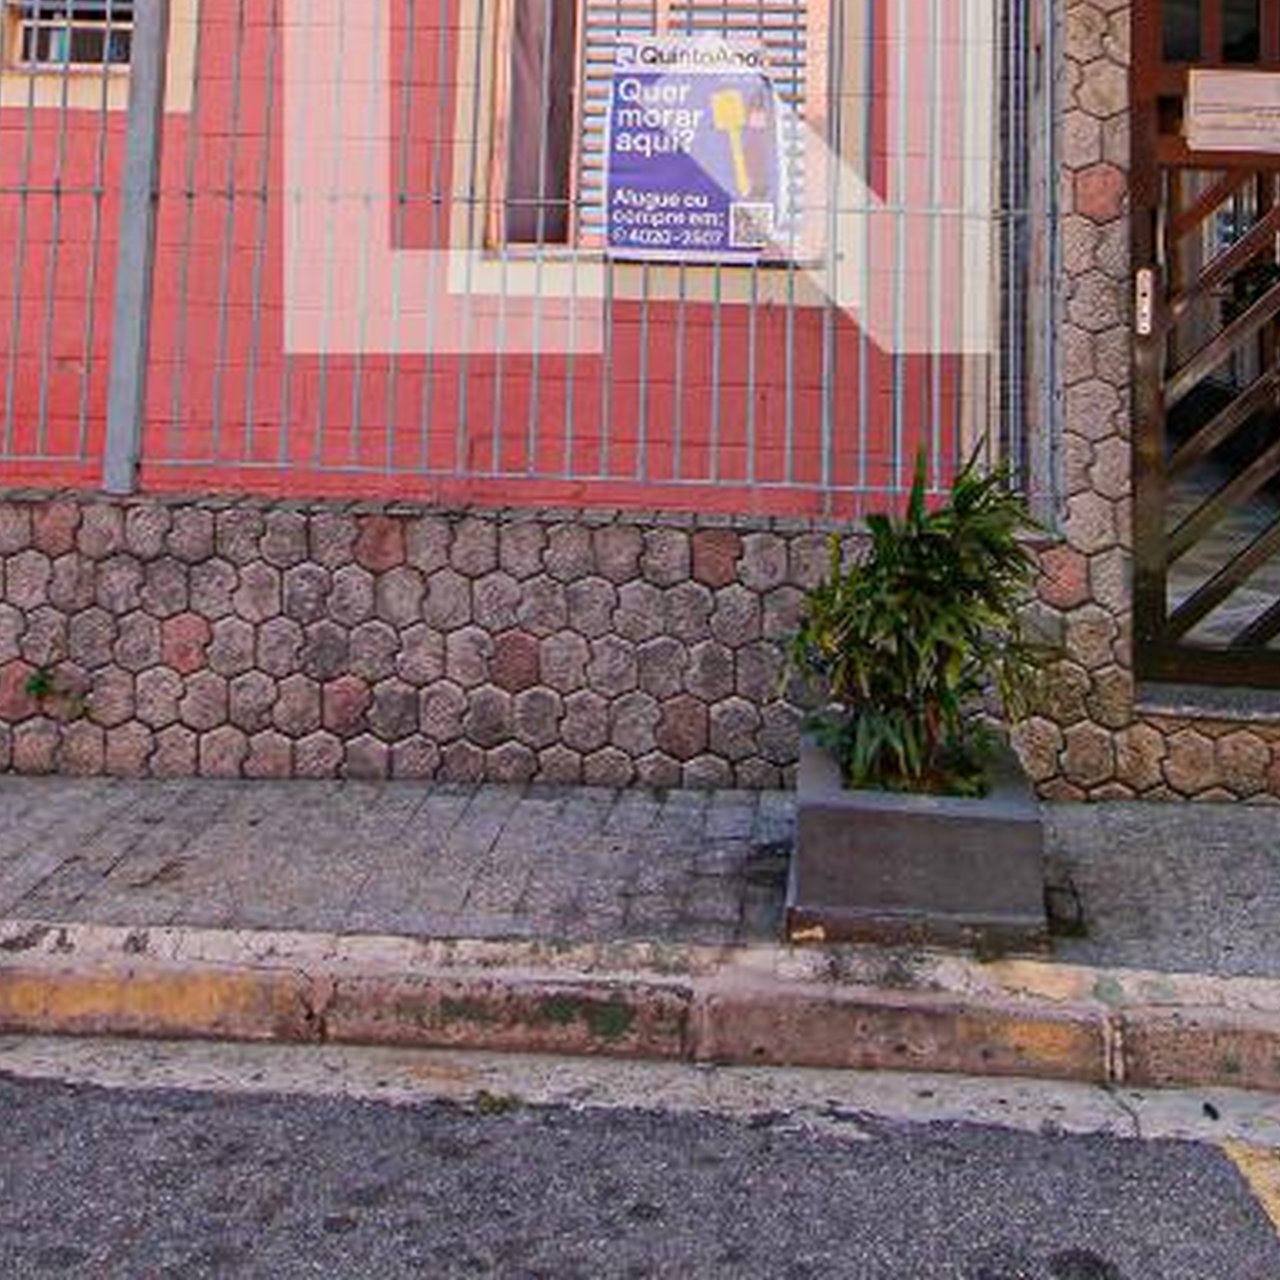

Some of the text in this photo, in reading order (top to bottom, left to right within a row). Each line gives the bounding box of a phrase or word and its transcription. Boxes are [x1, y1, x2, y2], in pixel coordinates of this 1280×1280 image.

[618, 108, 700, 128] morar
[615, 128, 694, 157] aqui?
[612, 189, 708, 211] Alugue ou
